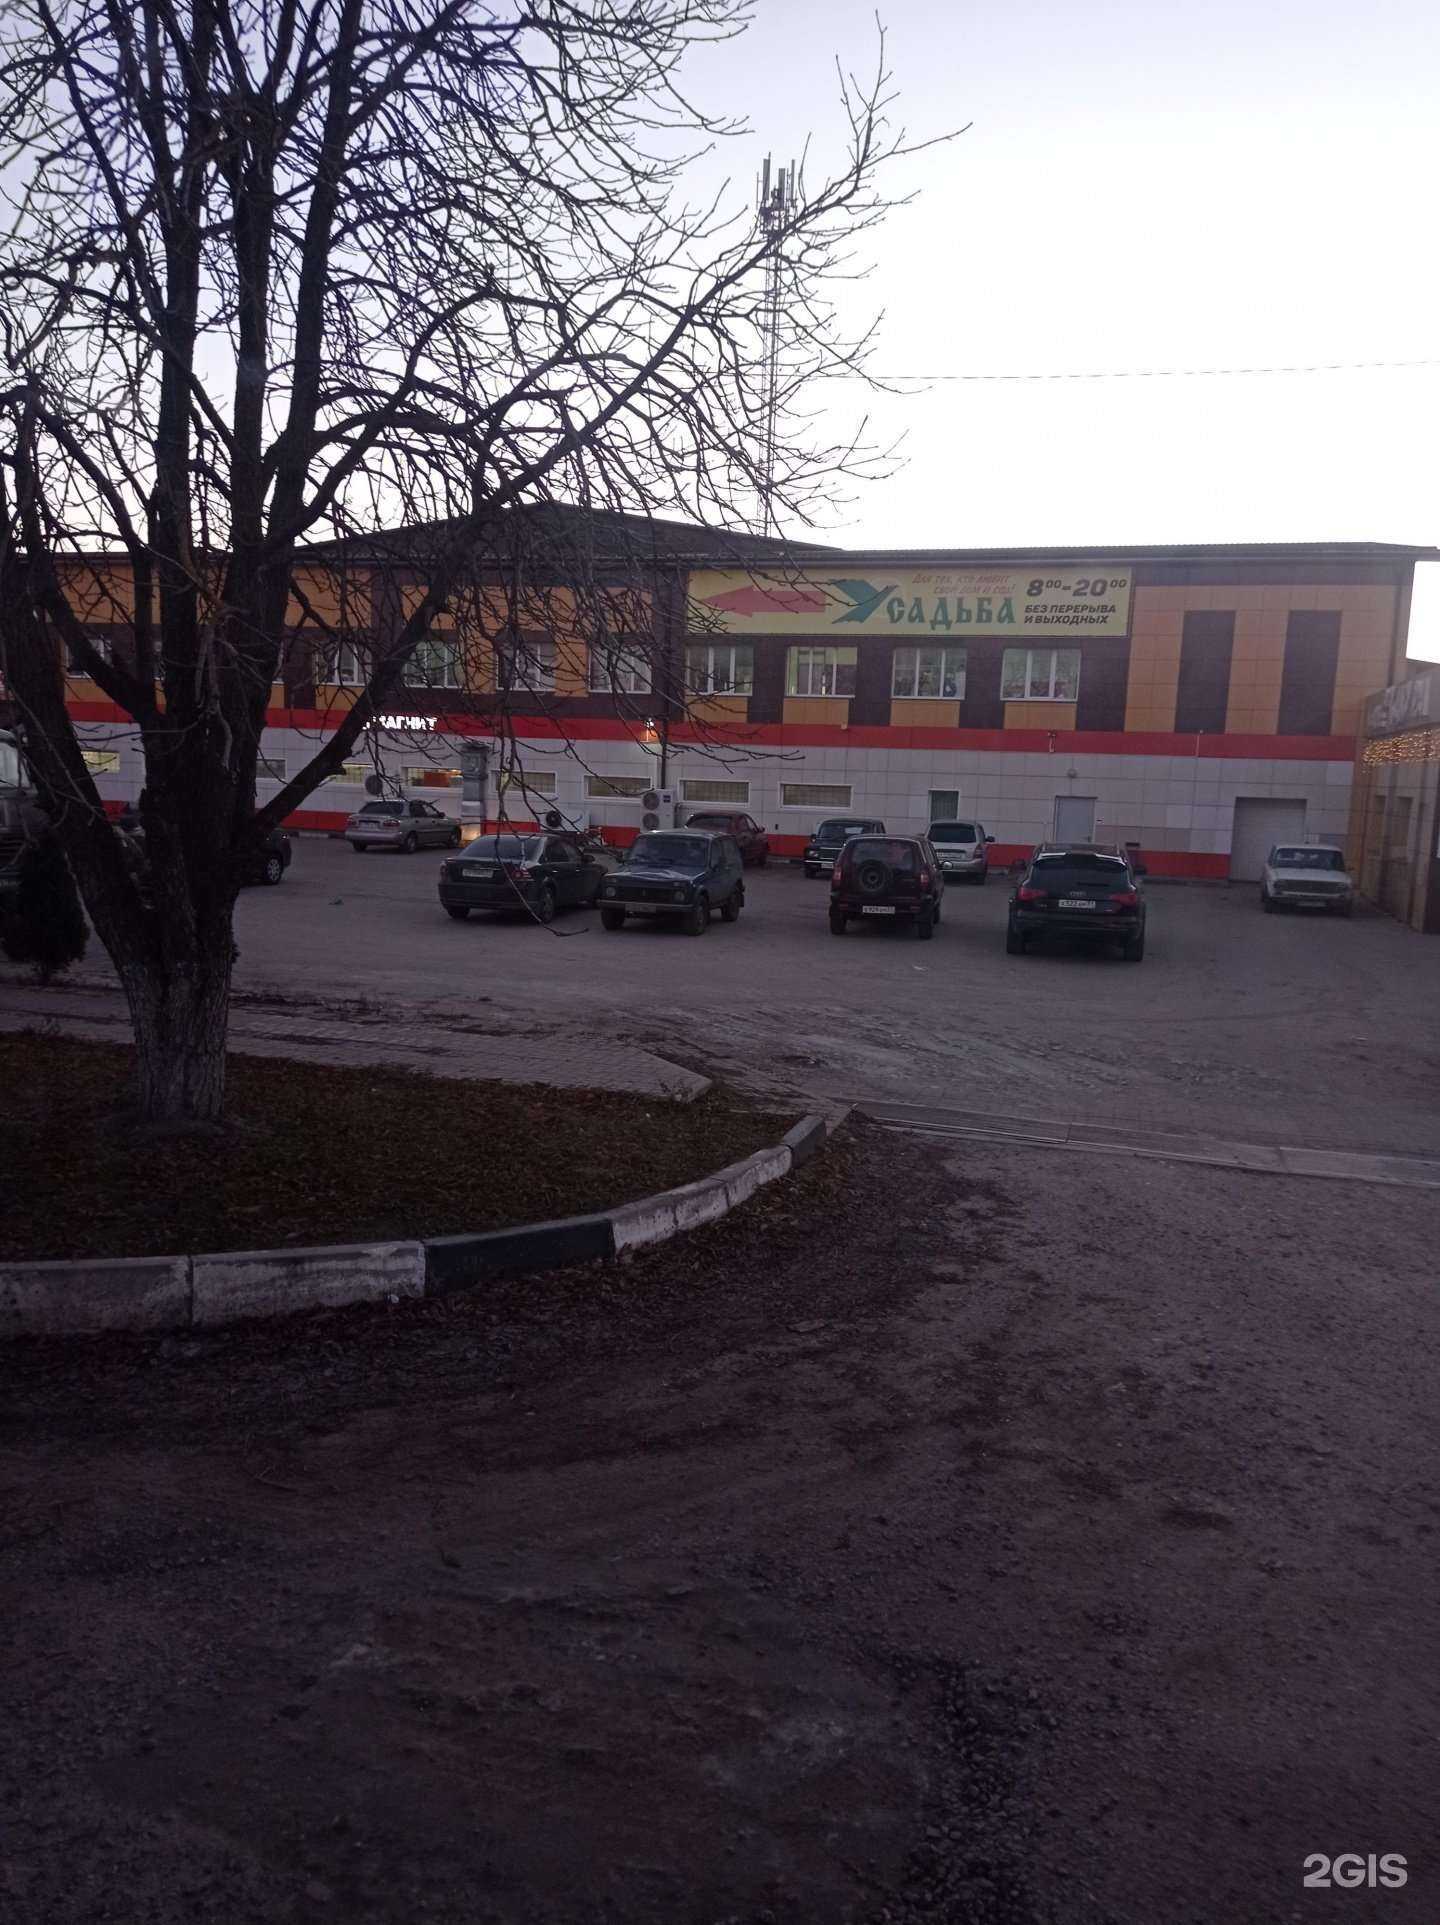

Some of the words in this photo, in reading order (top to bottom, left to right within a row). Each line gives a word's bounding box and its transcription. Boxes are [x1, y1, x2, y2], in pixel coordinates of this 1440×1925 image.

[1025, 604, 1048, 613] БЕЗ
[1050, 604, 1116, 613] ПЕРЕРЫВА
[1024, 615, 1034, 624] И
[1035, 615, 1109, 625] ВЫХОДНЫХ
